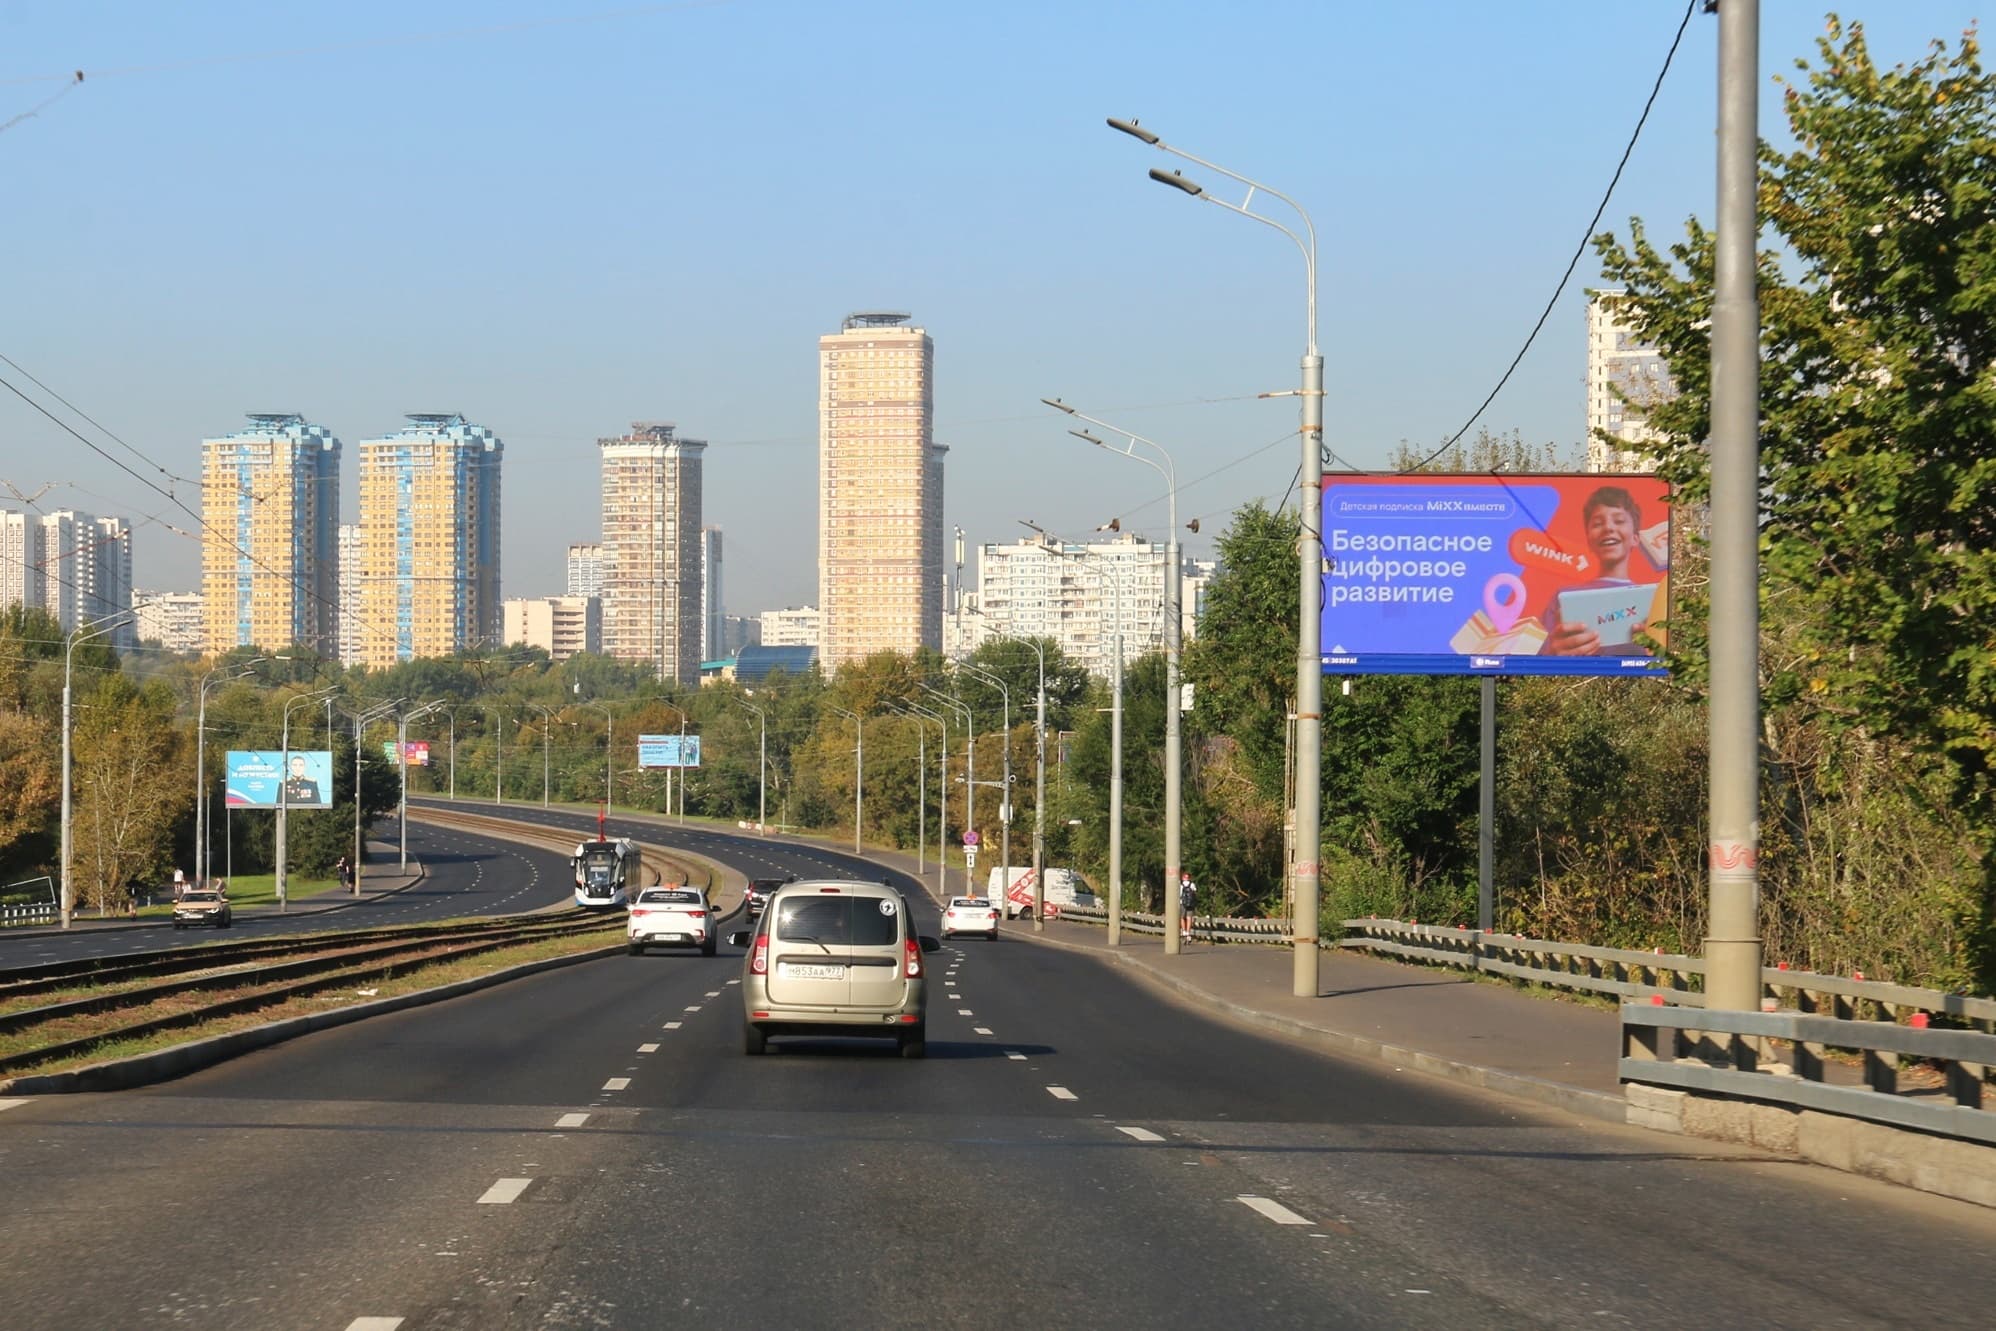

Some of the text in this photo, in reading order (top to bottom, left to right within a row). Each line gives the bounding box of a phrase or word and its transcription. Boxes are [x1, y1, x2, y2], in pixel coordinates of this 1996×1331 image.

[1332, 529, 1492, 552] Безопасное
[1525, 542, 1573, 565] WINK
[1332, 555, 1467, 582] цифровое
[1332, 586, 1454, 607] развитие
